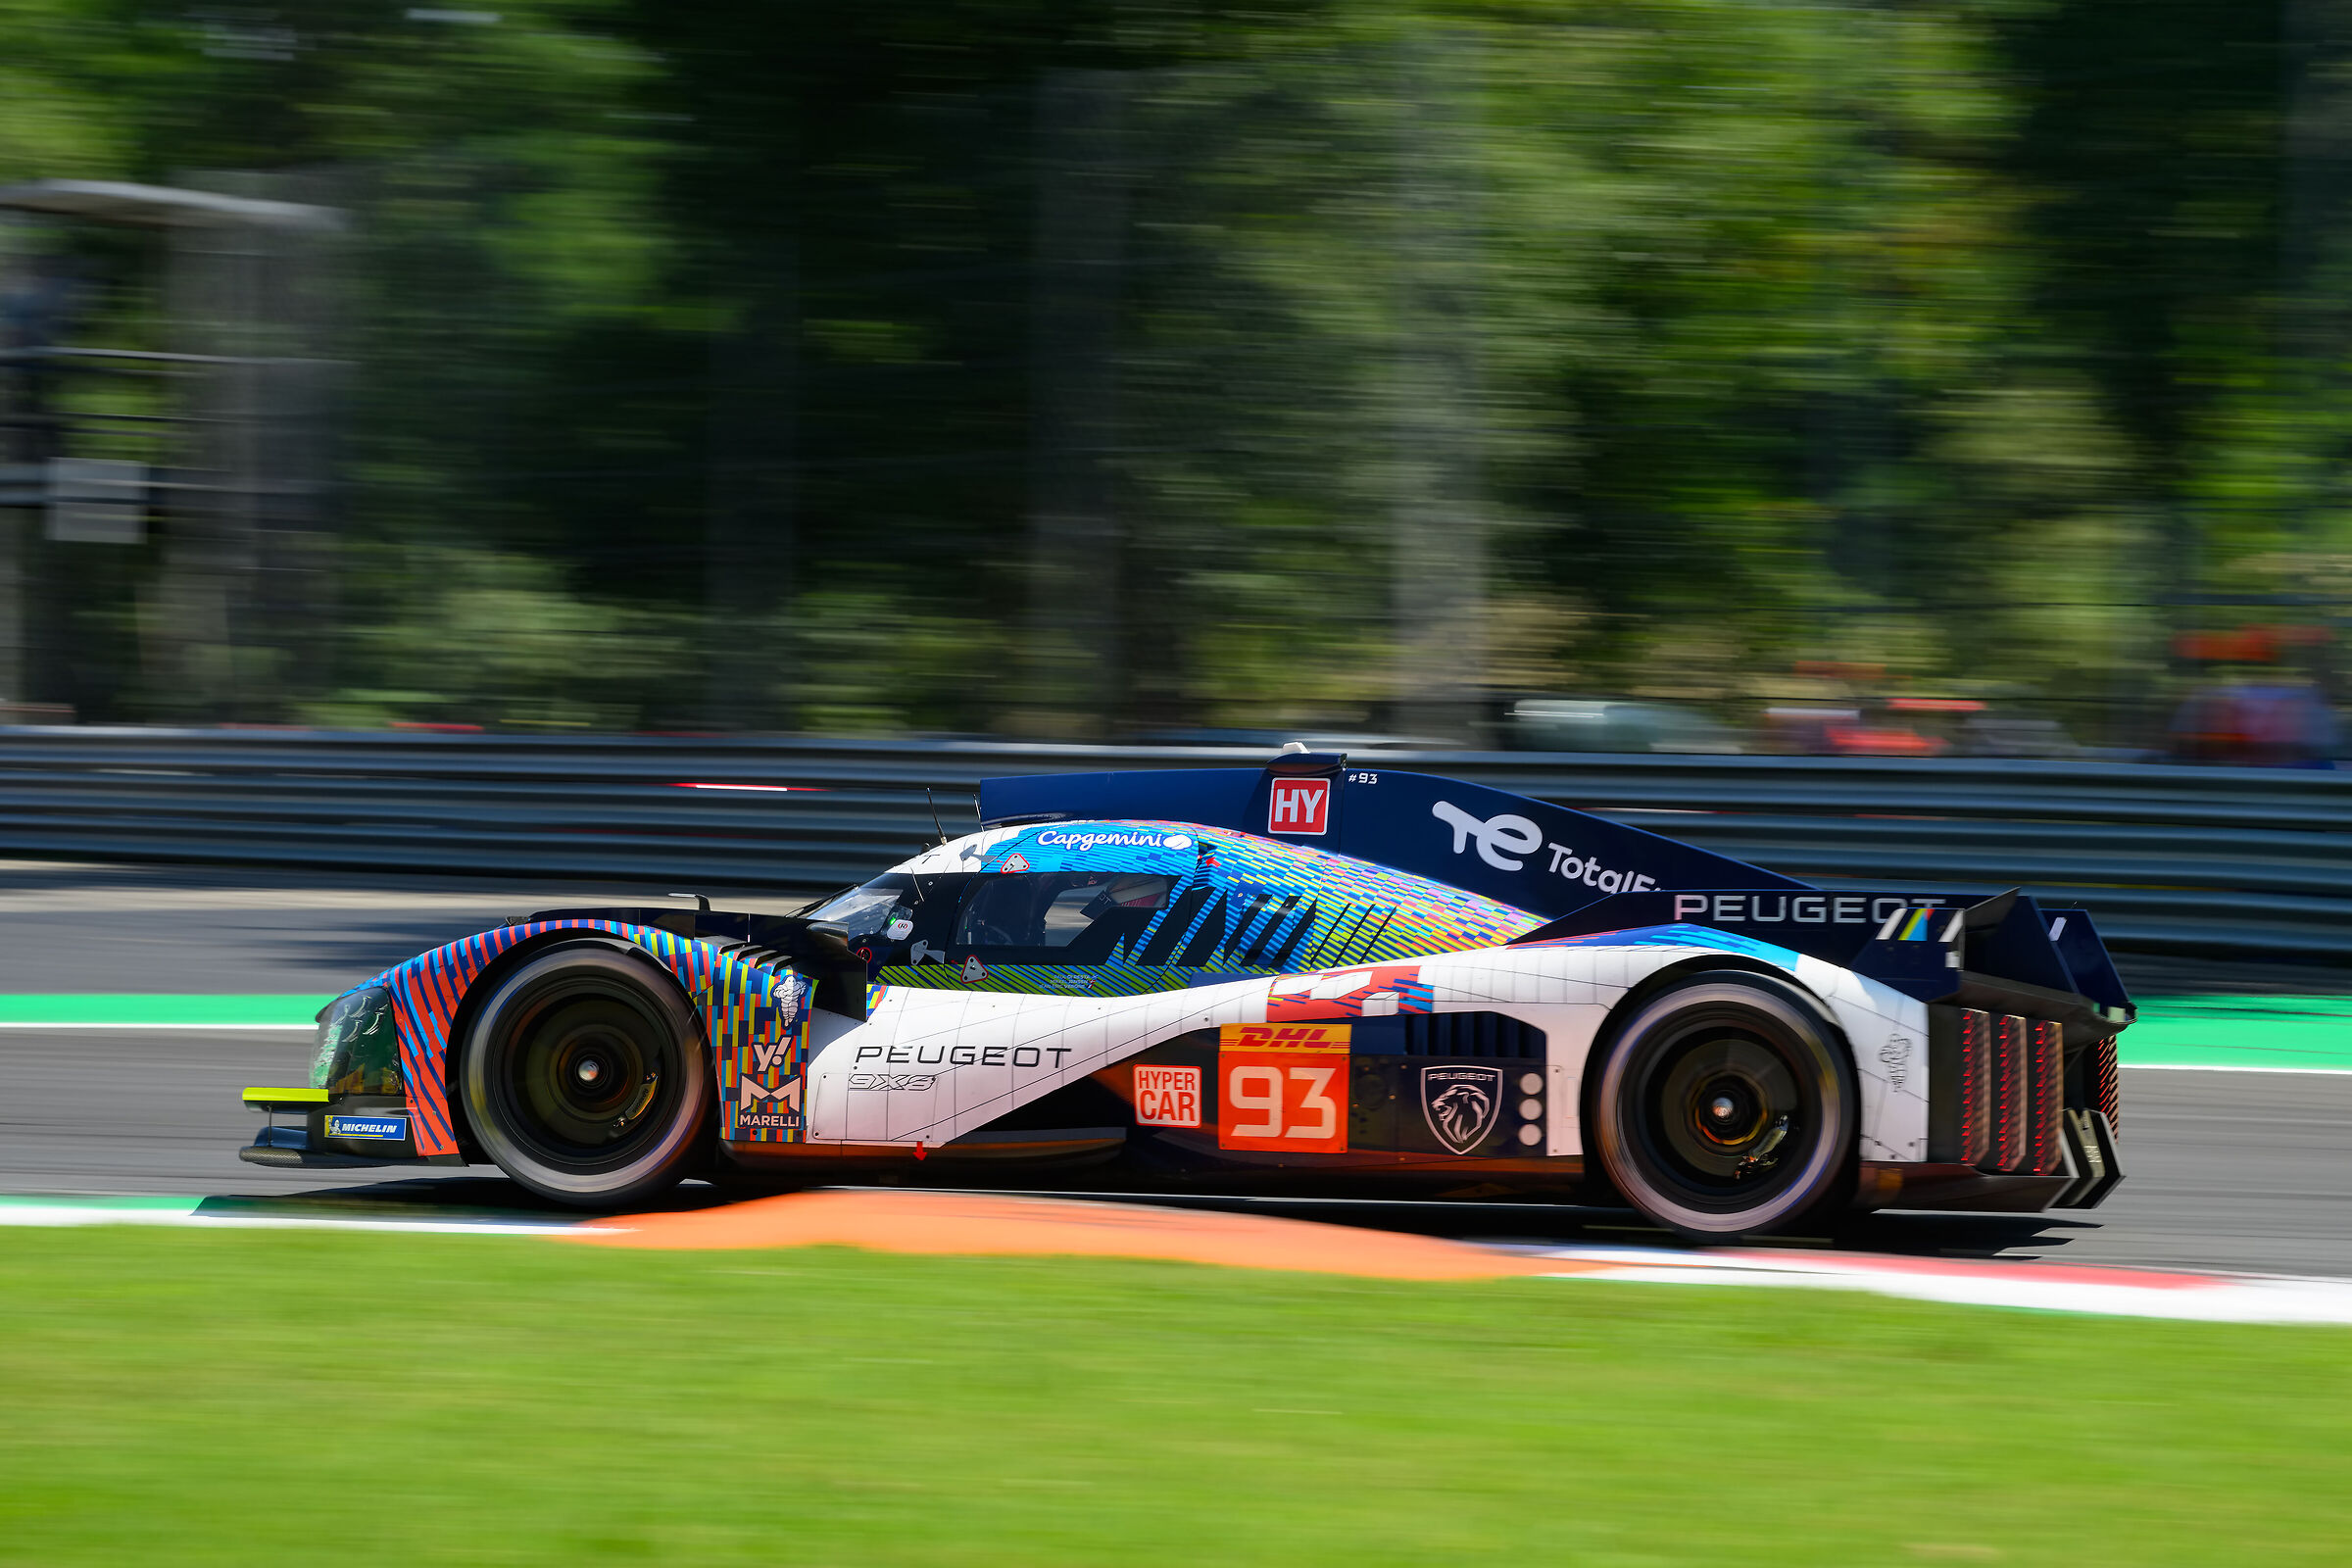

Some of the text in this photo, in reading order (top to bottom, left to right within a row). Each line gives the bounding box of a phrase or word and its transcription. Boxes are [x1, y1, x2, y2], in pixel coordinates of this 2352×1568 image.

[1348, 772, 1378, 785] #93
[1274, 788, 1325, 823] HY
[1037, 830, 1162, 852] Capgemini
[1547, 842, 1661, 894] TotalE
[1238, 1027, 1332, 1049] DHL
[855, 1046, 1072, 1069] PEUGEOT
[848, 1074, 937, 1091] 9X8
[1139, 1071, 1195, 1091] HYPER
[1427, 1072, 1496, 1081] PEUGEOT
[1140, 1090, 1196, 1122] CAR
[1229, 1065, 1337, 1139] 93
[341, 1123, 398, 1134] MICHELIN
[739, 1114, 800, 1127] MARELLI
